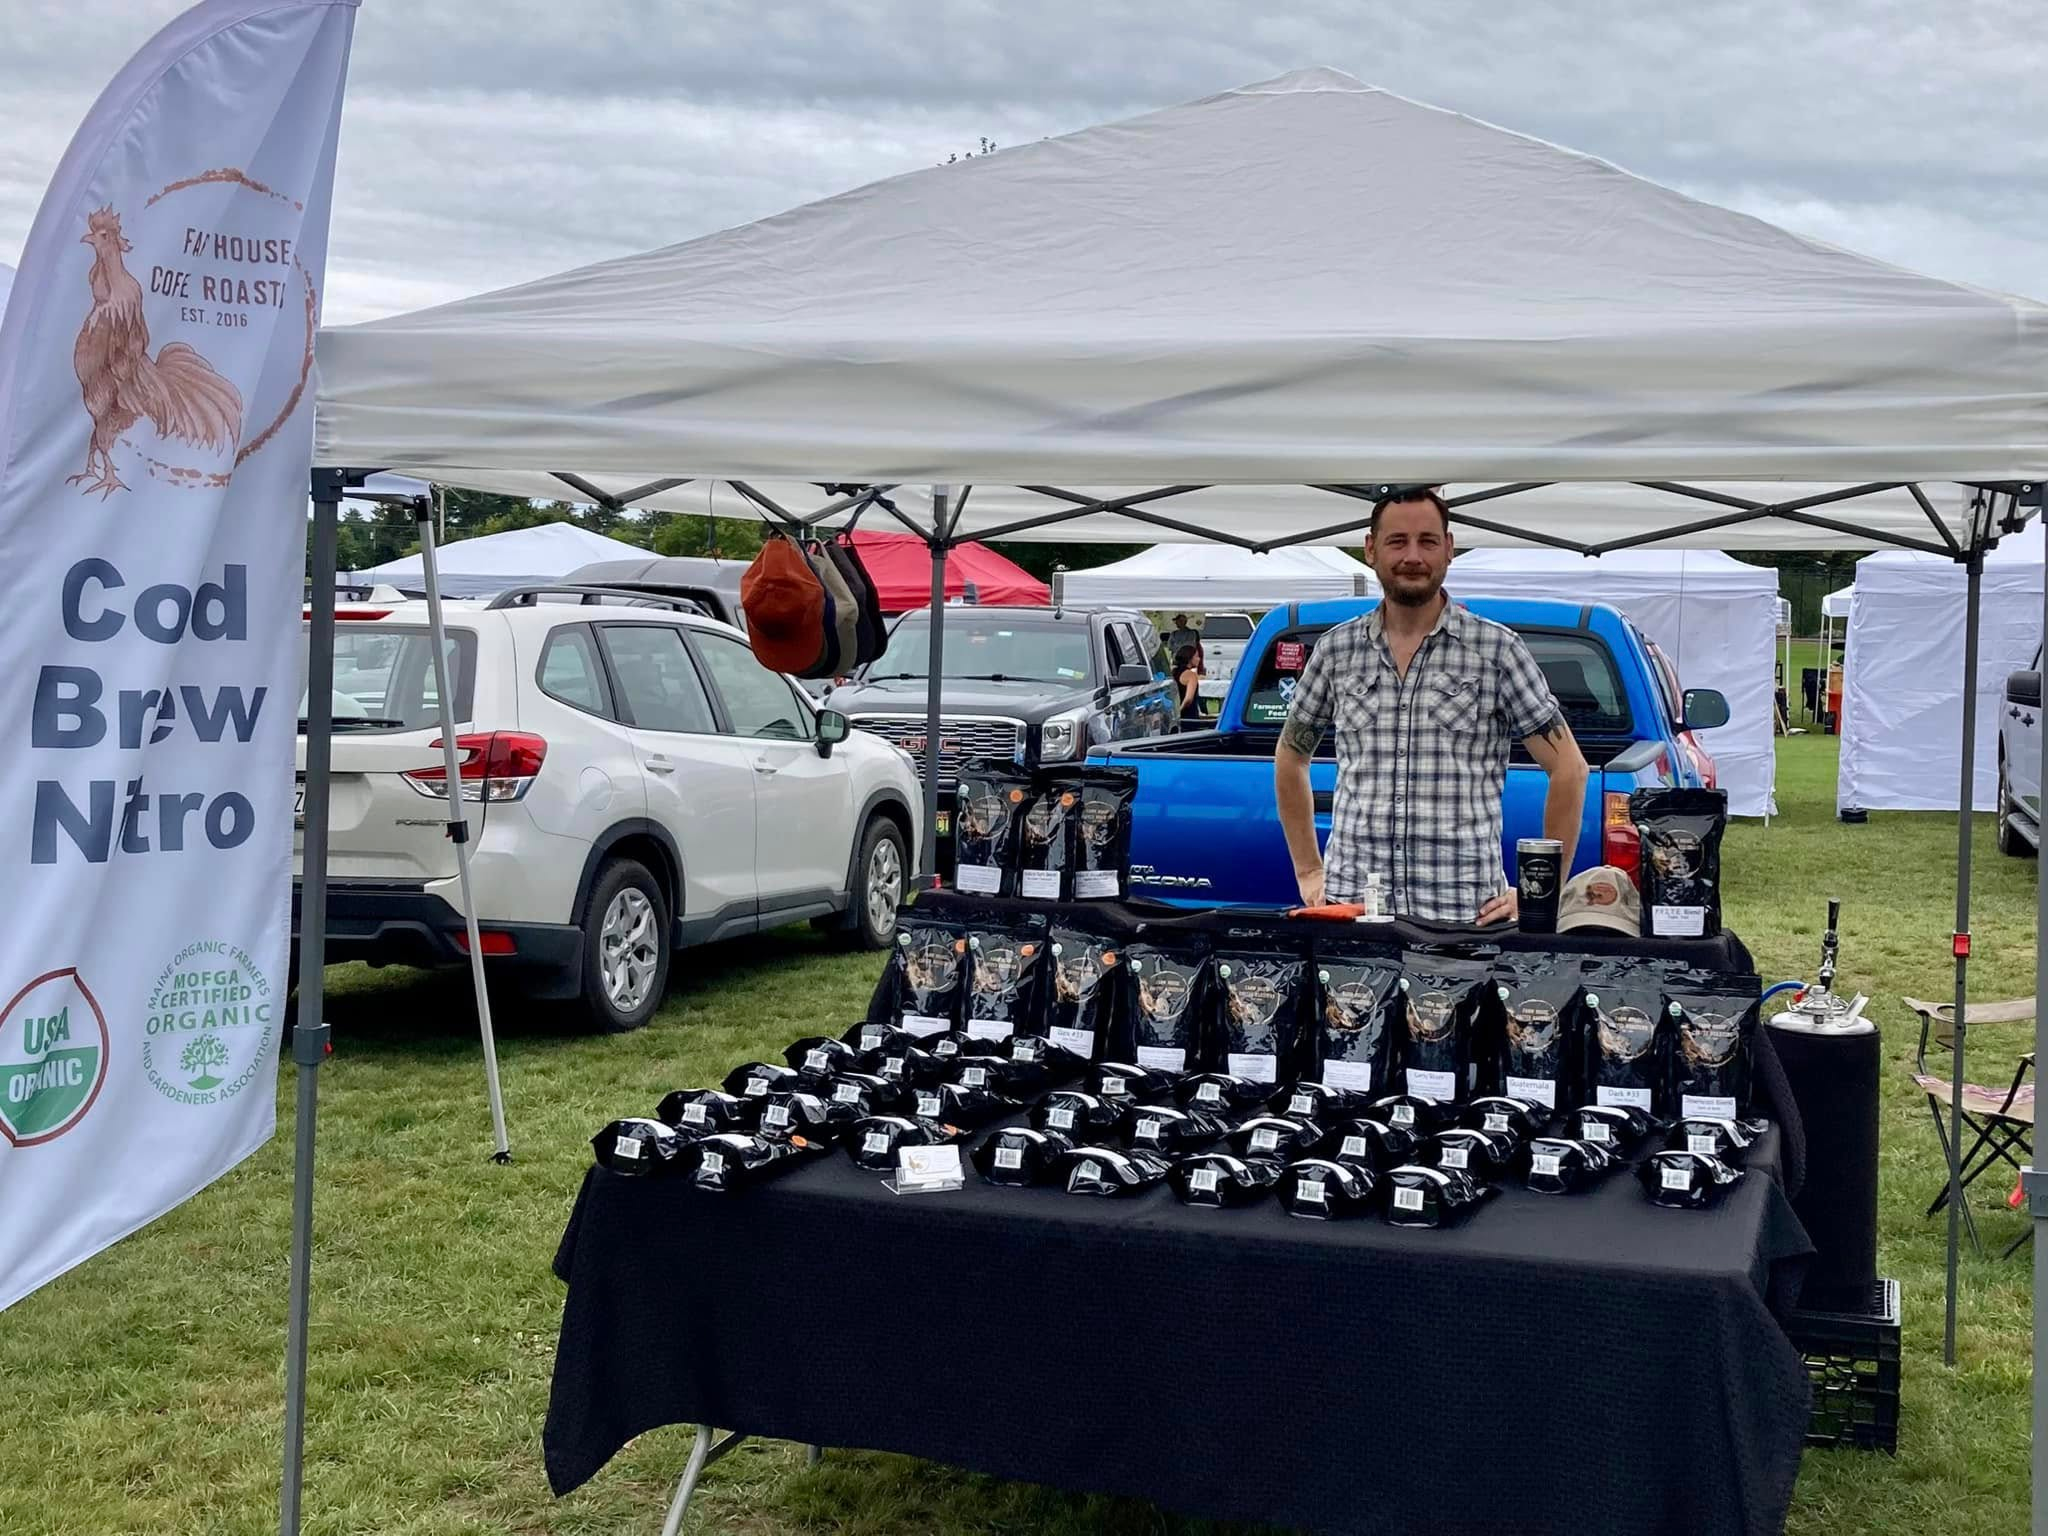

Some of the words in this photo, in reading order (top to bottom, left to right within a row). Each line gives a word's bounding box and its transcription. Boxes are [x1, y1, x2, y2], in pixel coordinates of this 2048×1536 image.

[214, 233, 292, 265] HOUSE
[181, 307, 210, 325] EST.
[217, 312, 248, 327] 2016
[31, 665, 268, 749] Brew
[901, 736, 961, 752] GC
[1128, 874, 1213, 888] ACOMA
[148, 963, 174, 1010] MAINE
[174, 941, 228, 966] ORGANIC
[229, 946, 271, 997] FARMERS
[174, 969, 239, 989] MOFGA
[160, 985, 252, 1009] CERTIFIED
[23, 1006, 71, 1055] USA
[146, 1003, 271, 1036] ORGANIC
[148, 1069, 217, 1105] GARDENERS
[220, 1026, 272, 1101] ASSOCIATION
